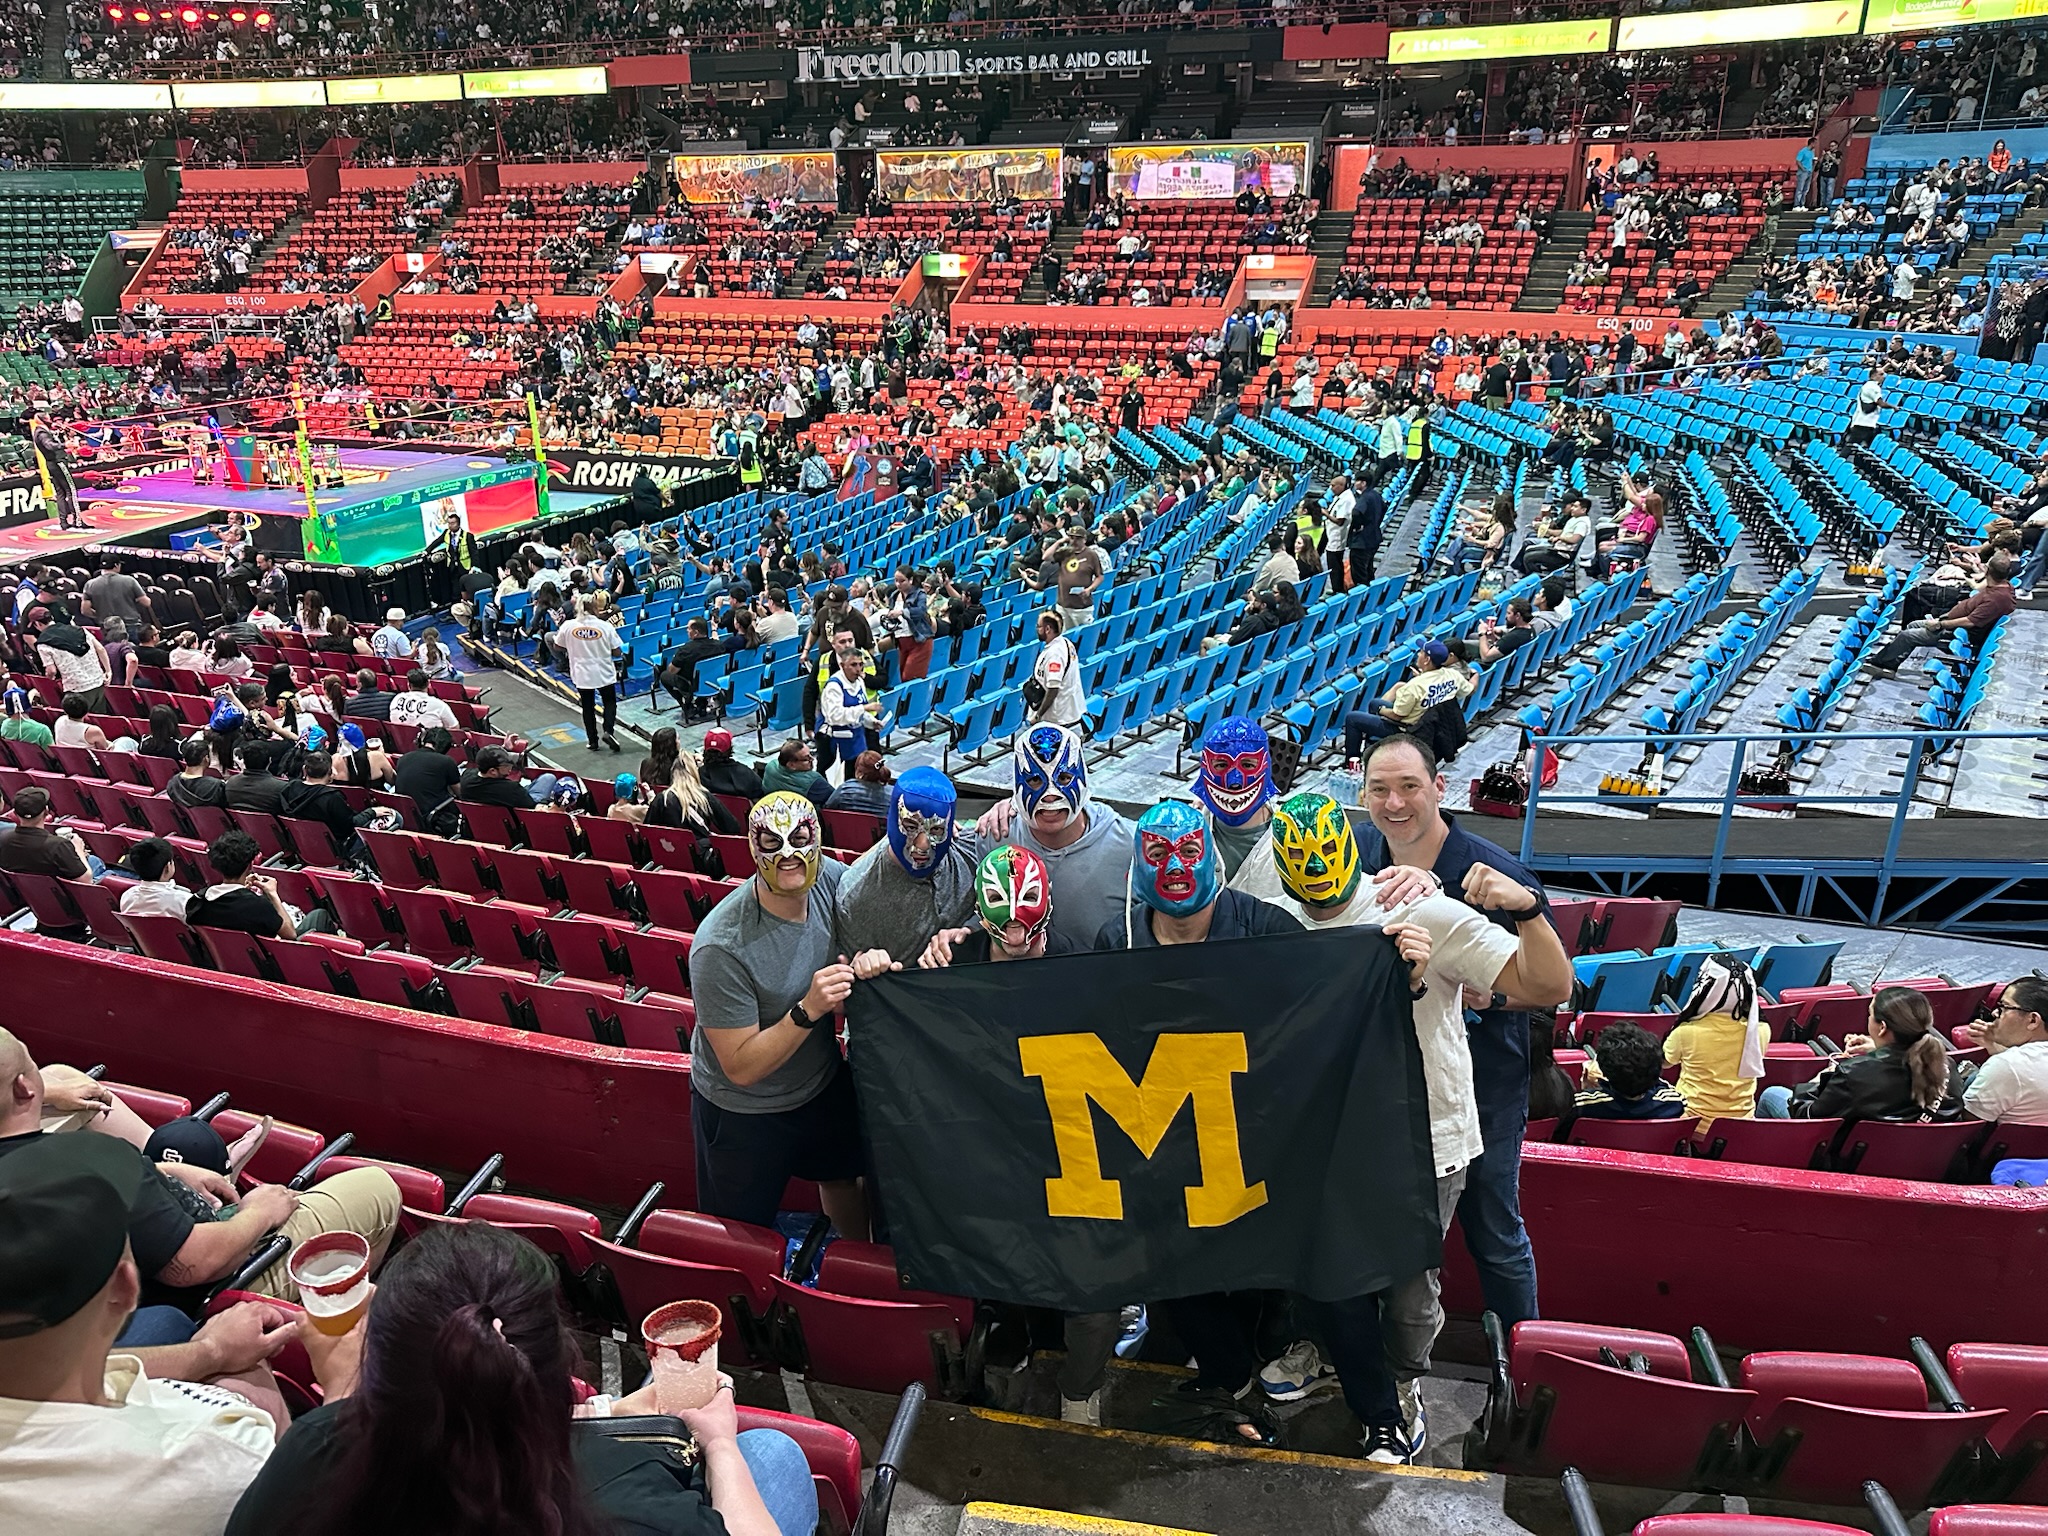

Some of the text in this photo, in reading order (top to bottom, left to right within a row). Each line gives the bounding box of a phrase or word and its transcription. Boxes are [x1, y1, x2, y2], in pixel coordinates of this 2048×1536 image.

[797, 41, 1152, 81] Freedom SPORTS BAR AND GRILL
[250, 296, 266, 305] 100
[391, 697, 428, 714] ACE
[1018, 1032, 1268, 1228] M
